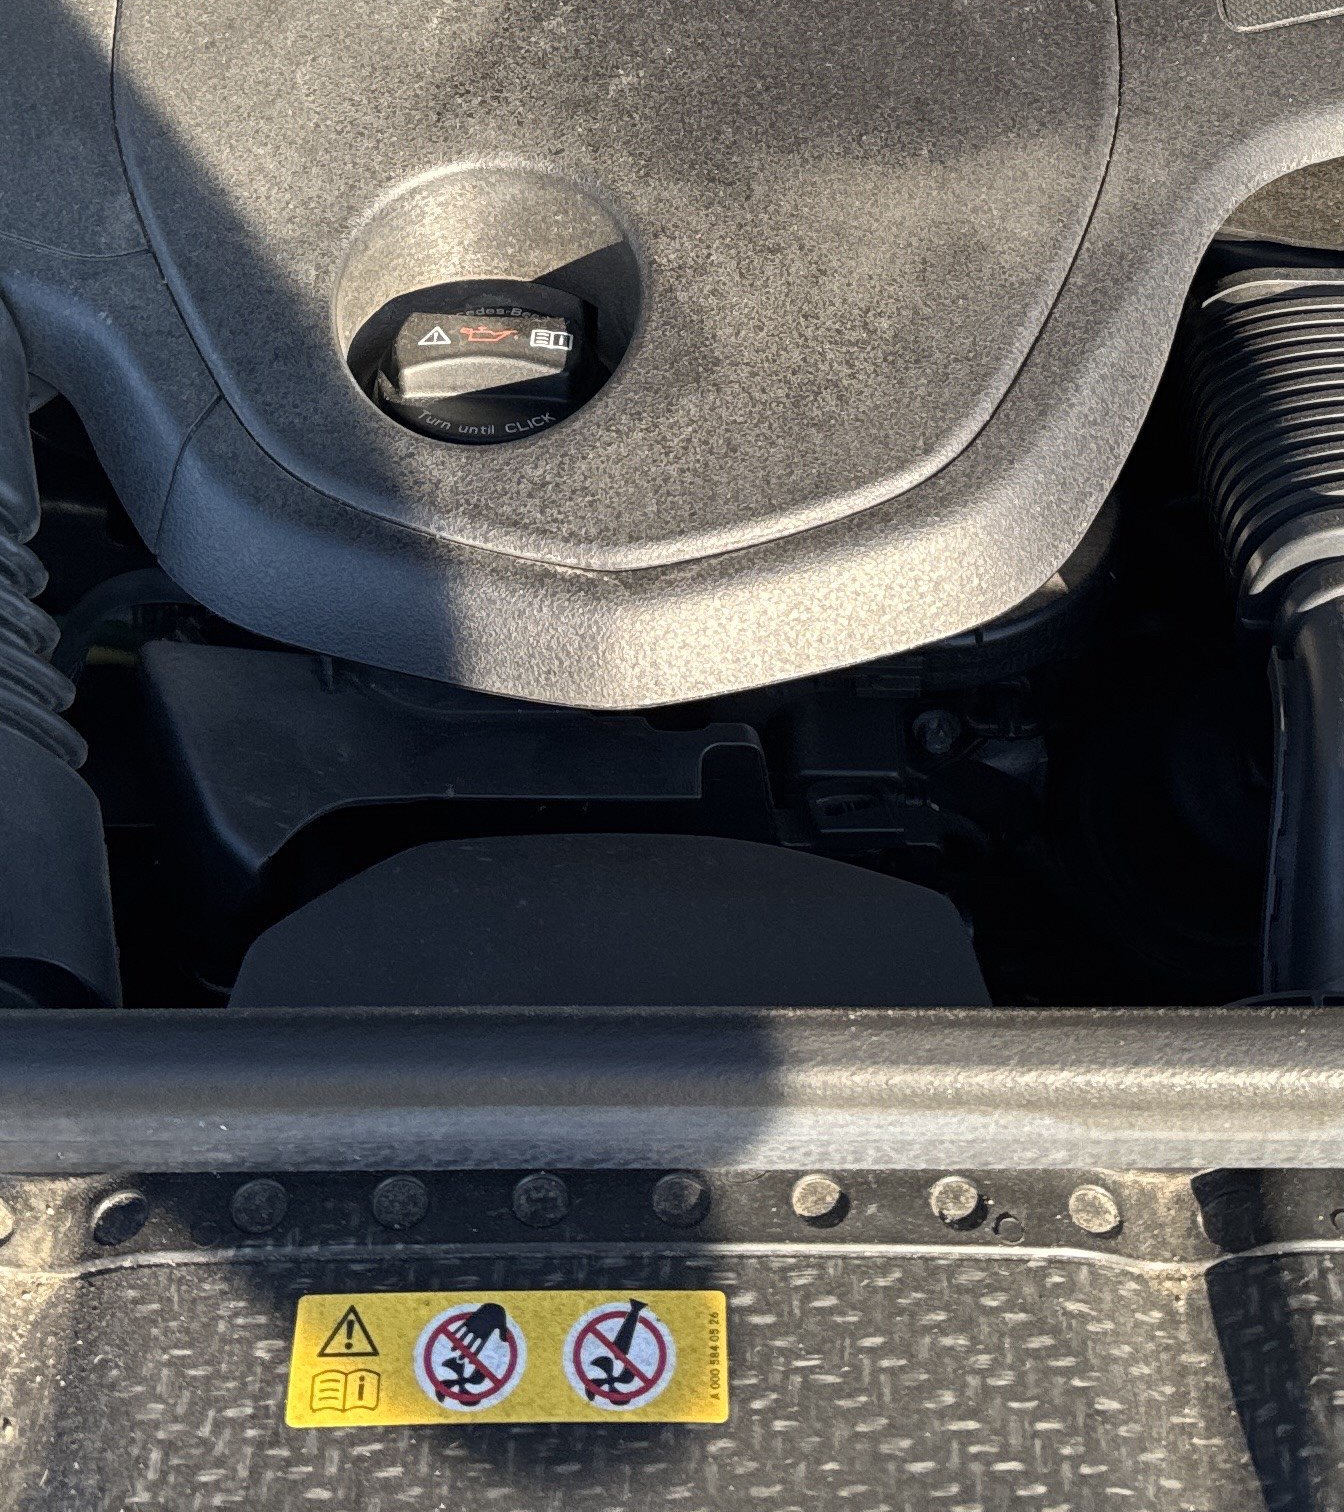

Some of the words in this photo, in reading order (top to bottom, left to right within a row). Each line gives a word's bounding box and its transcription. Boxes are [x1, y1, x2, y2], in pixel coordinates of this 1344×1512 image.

[418, 409, 451, 430] Turn
[458, 424, 495, 435] until
[504, 412, 556, 433] CLICK
[708, 1311, 720, 1325] 26
[709, 1368, 720, 1390] 000
[709, 1392, 720, 1401] A
